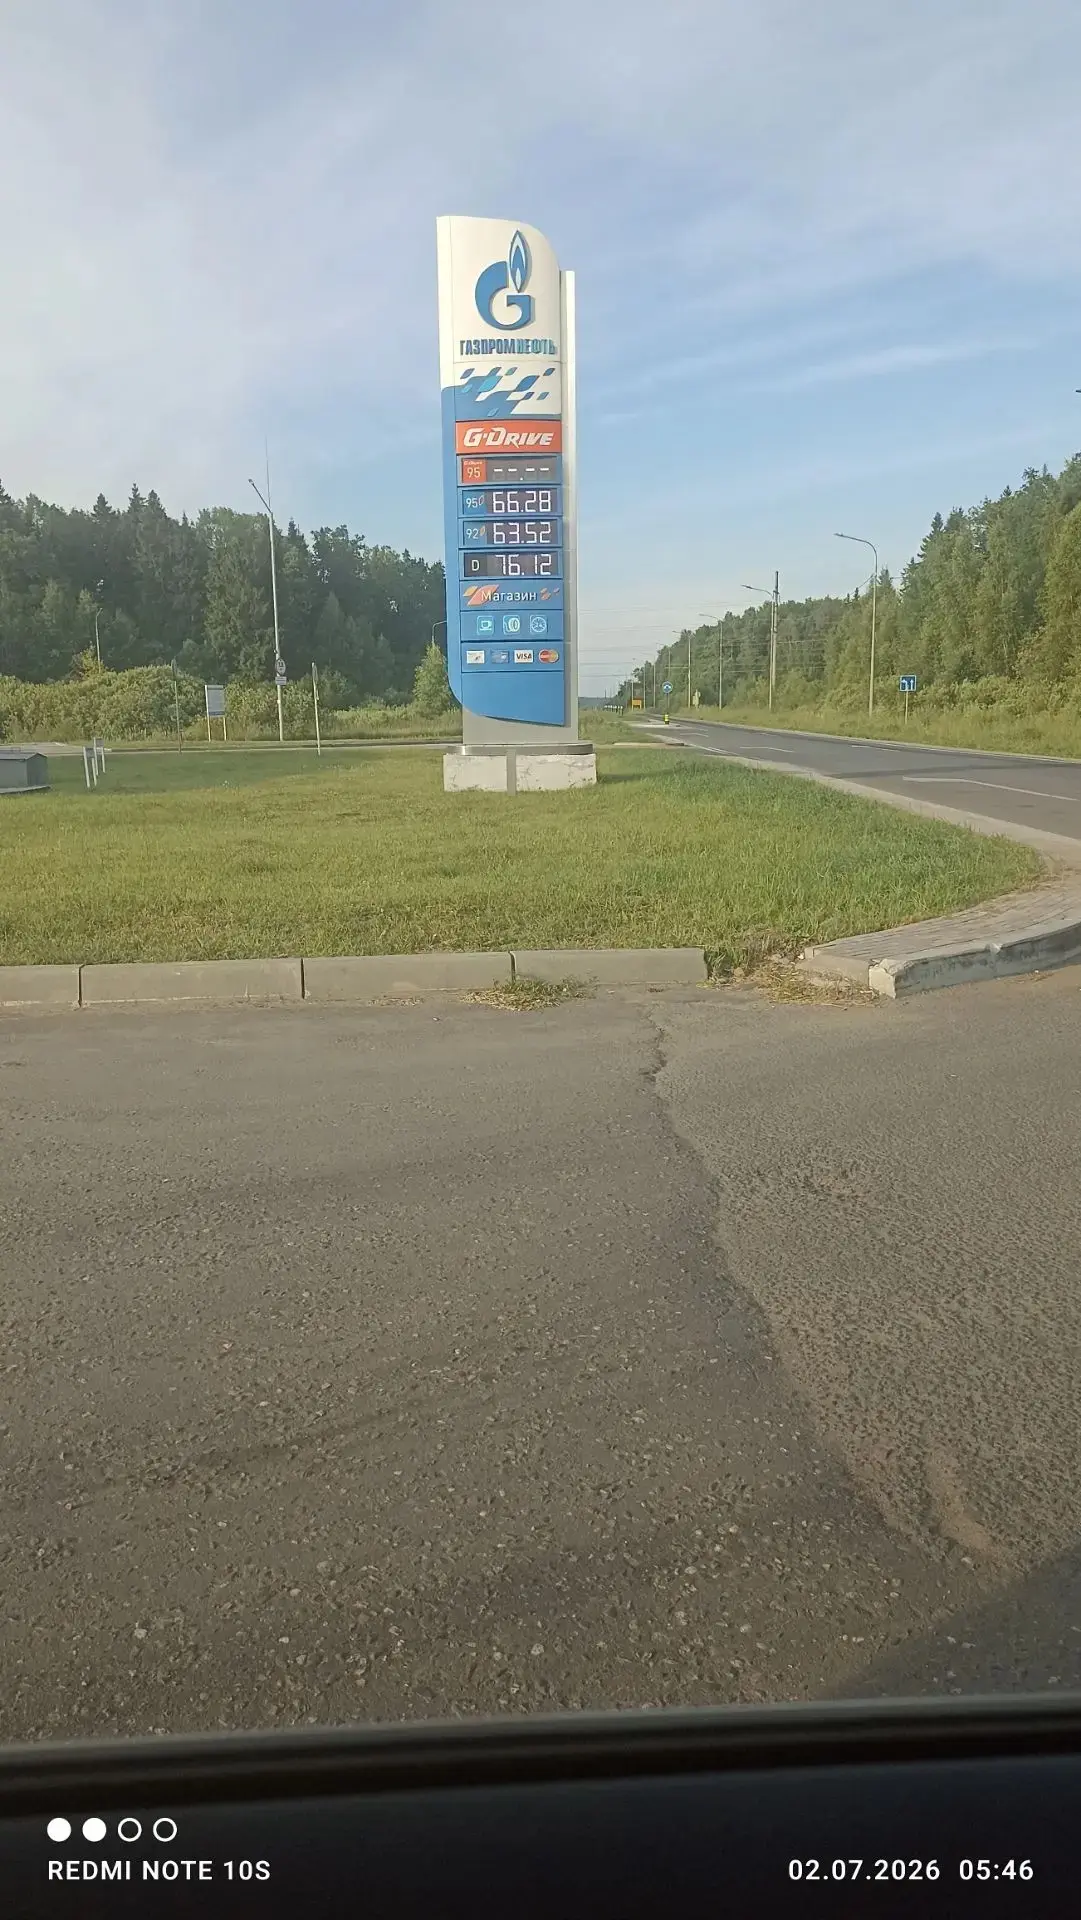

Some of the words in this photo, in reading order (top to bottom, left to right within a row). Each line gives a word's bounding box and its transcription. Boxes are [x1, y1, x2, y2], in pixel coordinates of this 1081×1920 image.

[460, 338, 557, 355] ГАЗПРОМНЕФТЬ
[467, 467, 481, 479] 95
[465, 497, 478, 509] 95
[492, 490, 551, 513] 66.28
[466, 528, 479, 539] 92
[493, 521, 551, 544] 63.52
[471, 559, 480, 571] D
[495, 554, 551, 576] 76.12
[481, 591, 537, 601] Магазин
